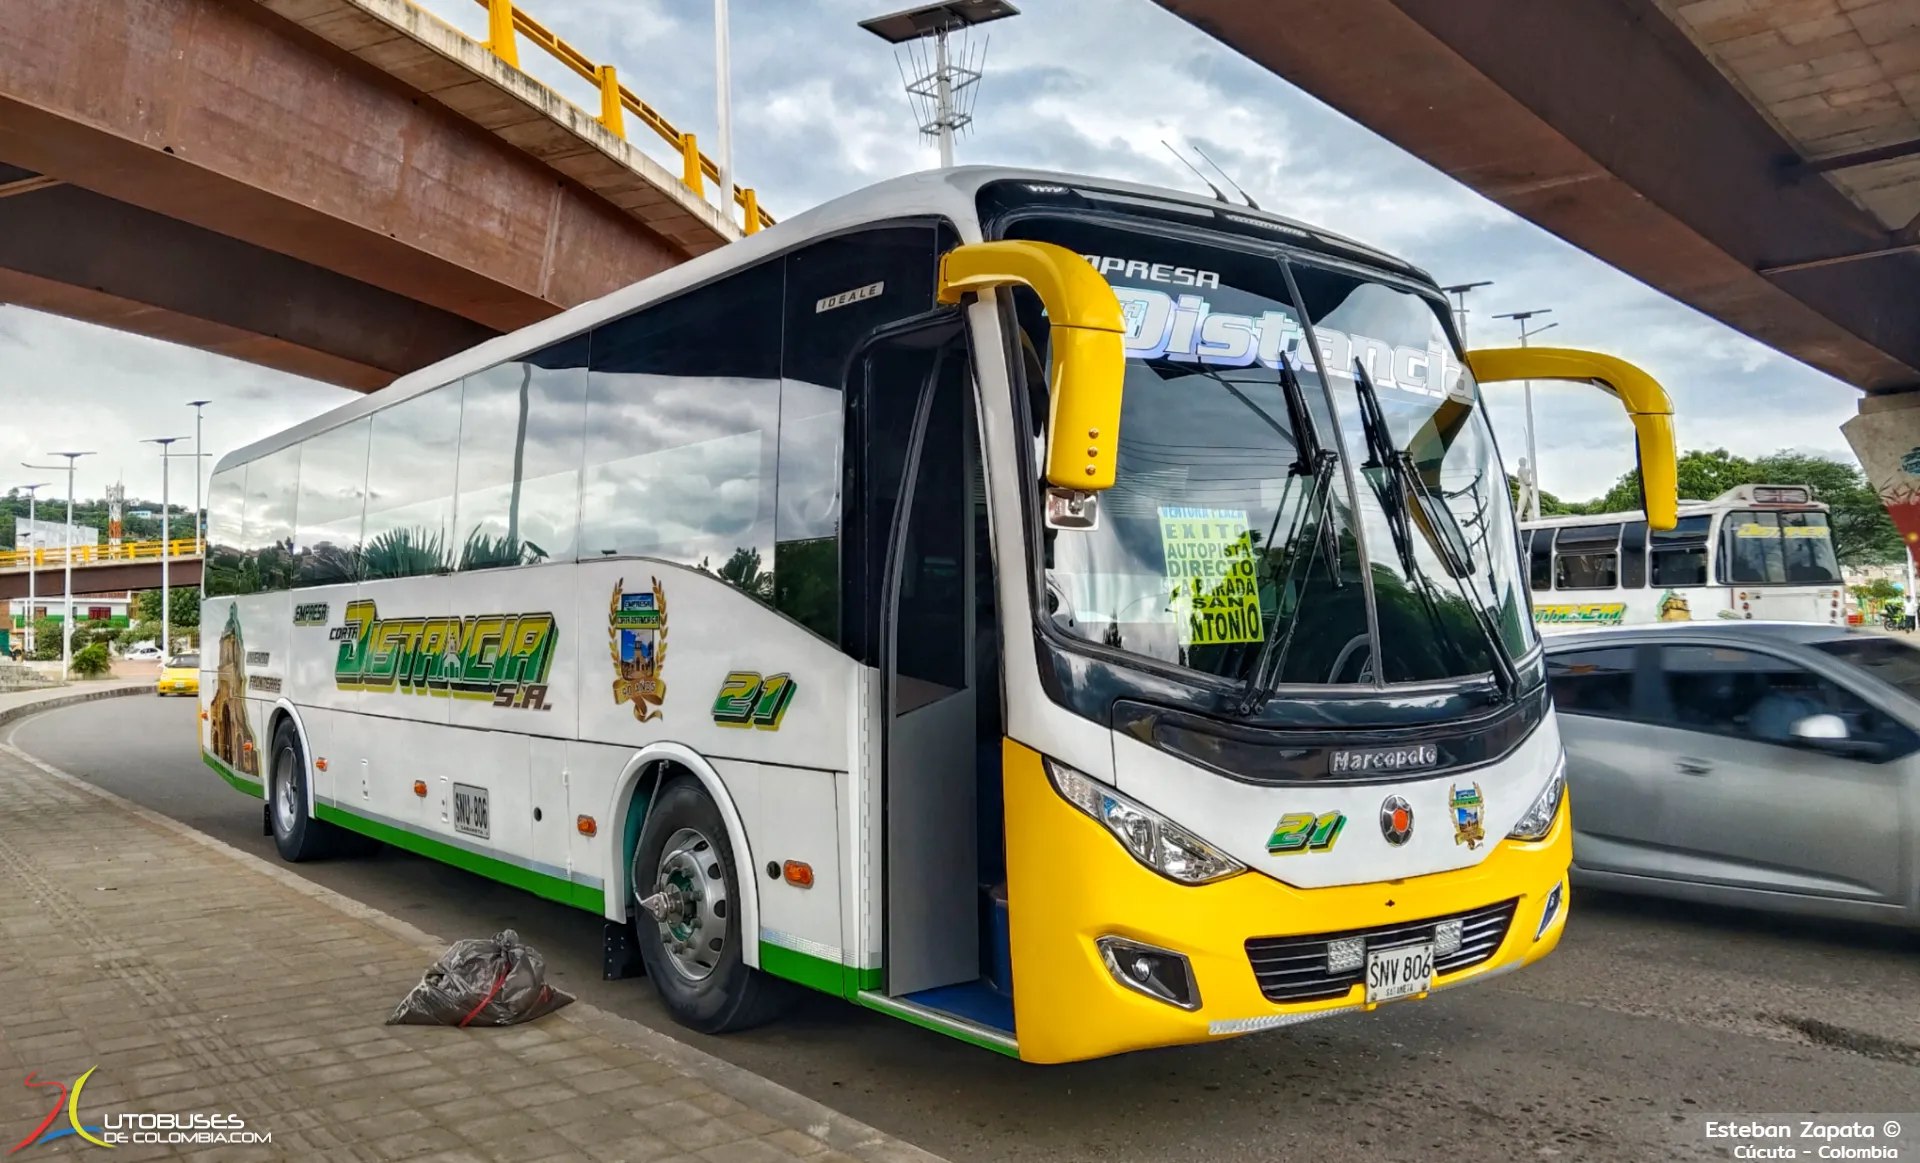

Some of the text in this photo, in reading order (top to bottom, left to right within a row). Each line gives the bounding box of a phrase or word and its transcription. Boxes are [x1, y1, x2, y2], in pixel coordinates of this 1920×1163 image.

[1079, 253, 1220, 289] MPRESA
[820, 285, 877, 309] IDEALE
[1165, 523, 1247, 540] EXITO
[1168, 543, 1251, 559] AUTOPISTA
[1168, 560, 1254, 577] DIRECTO
[1195, 578, 1256, 597] PARADA
[294, 602, 329, 625] EMPRESA
[1192, 597, 1244, 609] SAN
[329, 599, 558, 711] CORTA DISTANCIA S.A.
[711, 671, 797, 732] 21
[1333, 745, 1436, 772] Marcopolo
[1265, 809, 1347, 857] 21
[1370, 952, 1431, 989] SNV 806
